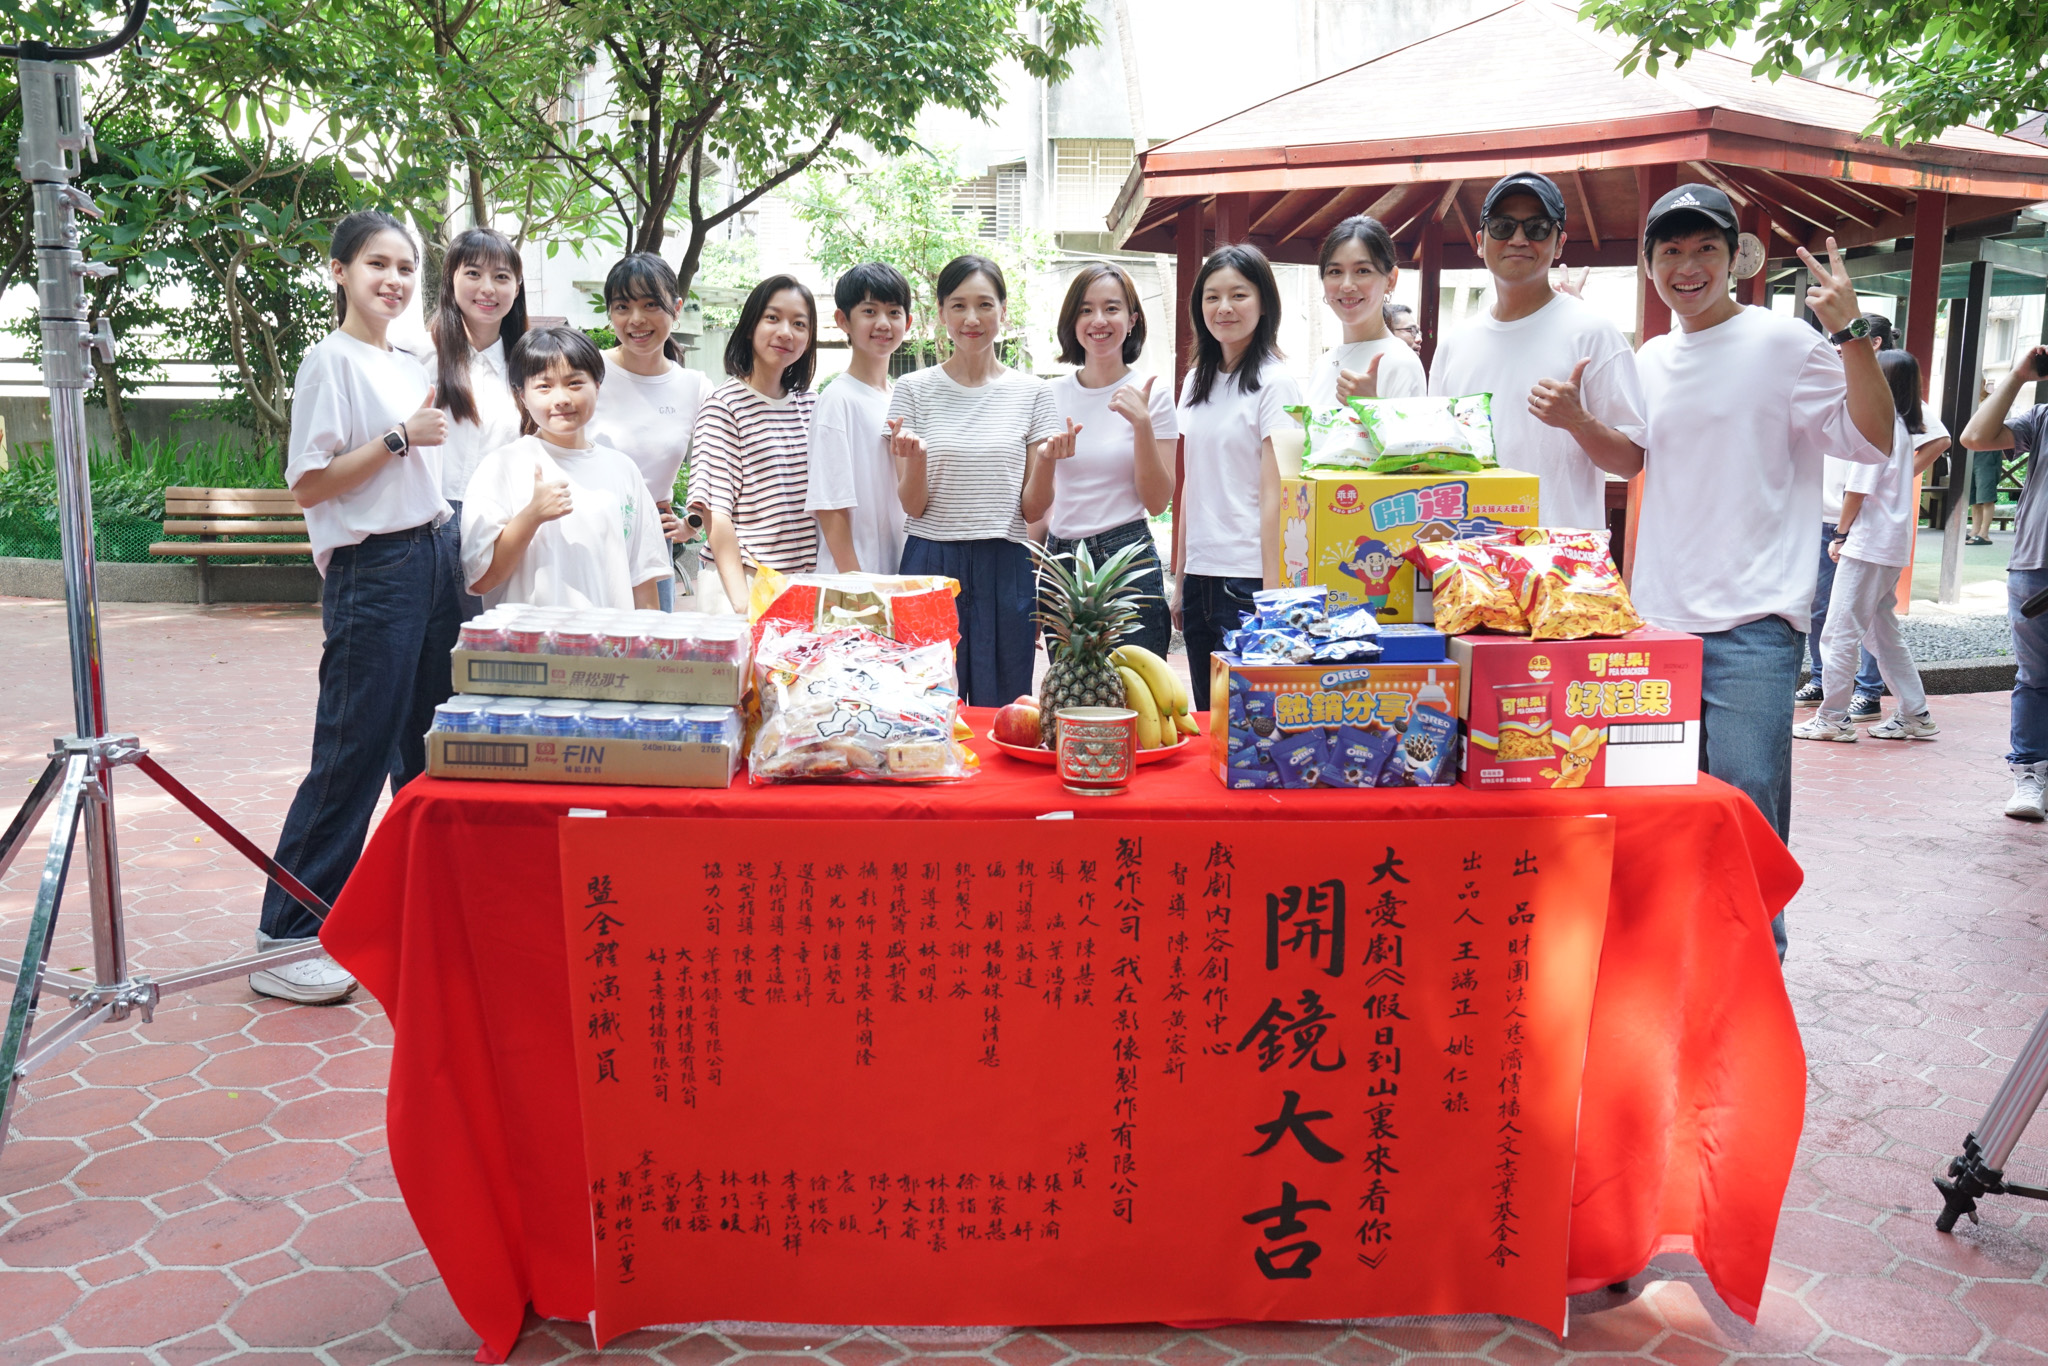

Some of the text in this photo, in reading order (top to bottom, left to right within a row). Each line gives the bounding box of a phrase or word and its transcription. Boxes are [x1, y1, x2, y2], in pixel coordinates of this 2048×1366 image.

[1670, 200, 1701, 209] adidas
[1337, 489, 1357, 502] 乖乖
[1371, 483, 1466, 531] 開運
[567, 670, 630, 689] 黑松沙士
[1321, 669, 1369, 686] OREO
[1608, 667, 1649, 676] PEA CRACKERS
[1275, 692, 1412, 724] 熱銷分享
[1566, 681, 1670, 717] 好結果
[1417, 713, 1451, 729] OREO
[561, 744, 606, 765] FIN
[1289, 748, 1316, 766] OREO
[1346, 747, 1374, 759] OREO
[1197, 840, 1238, 1056] 戲劇內容創作中心
[1235, 877, 1347, 1281] 開鏡大吉
